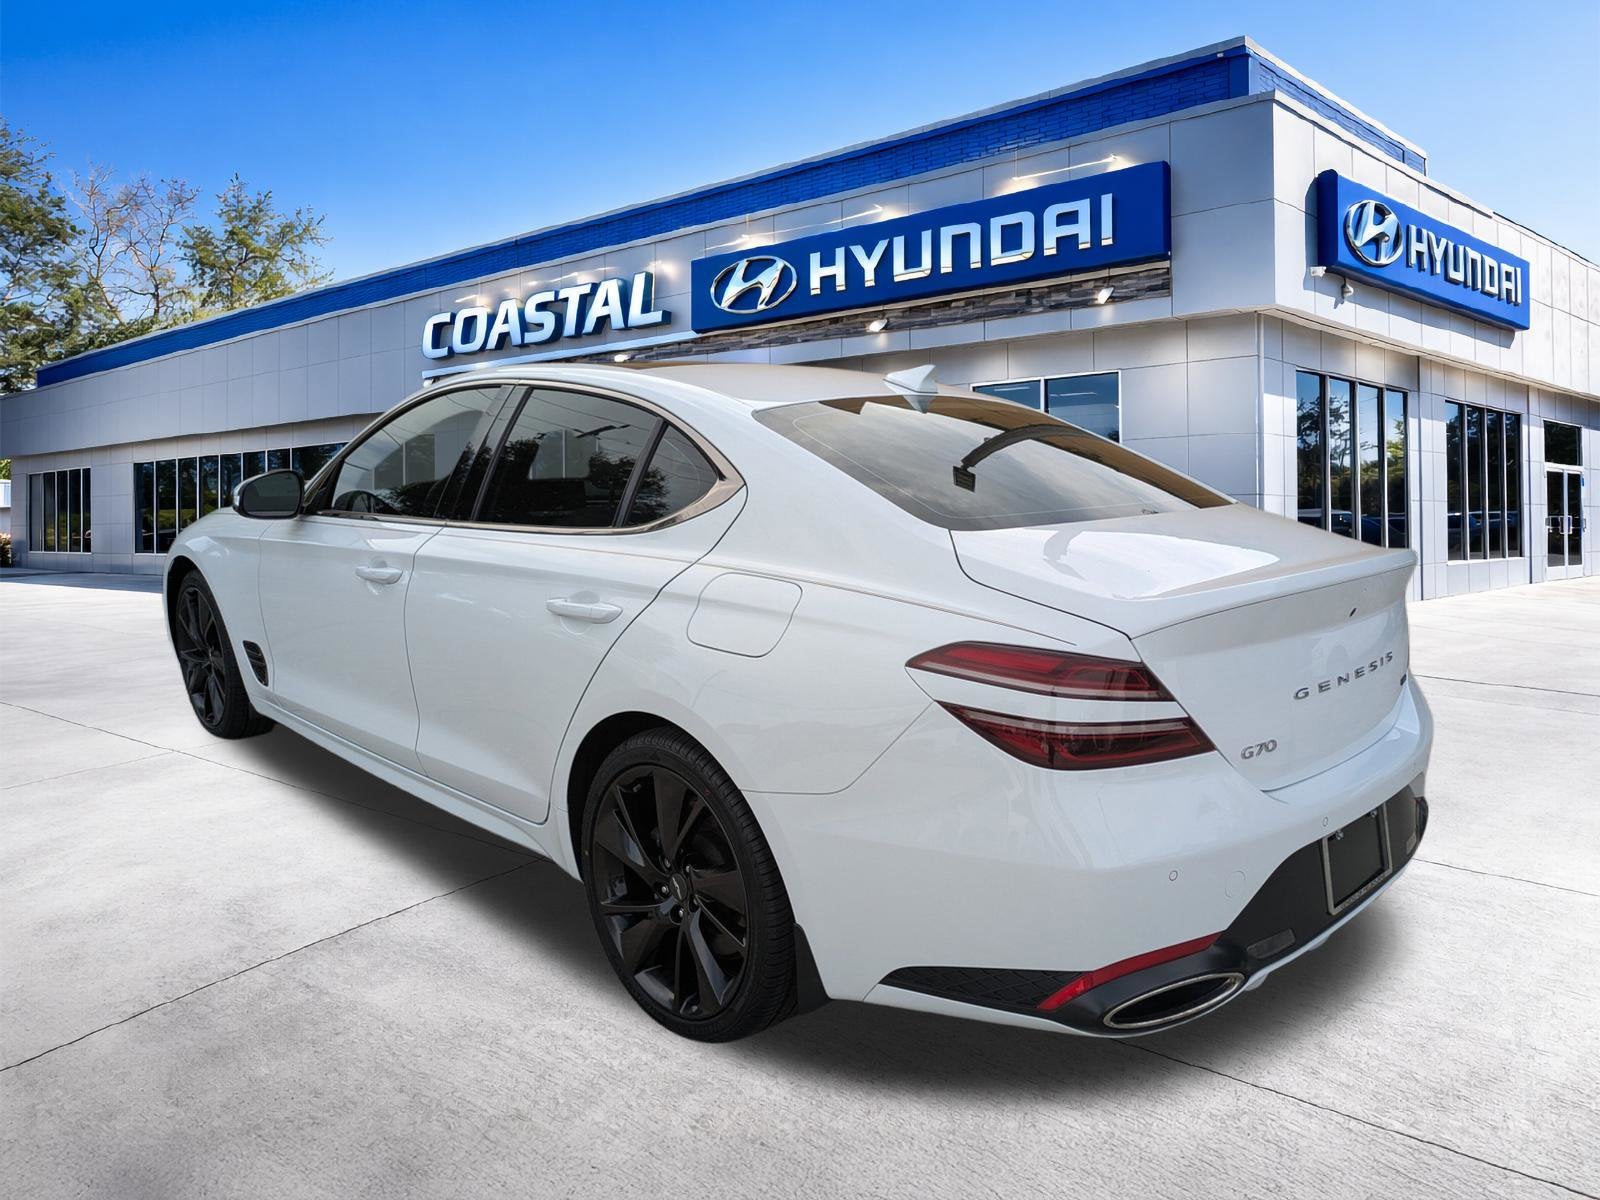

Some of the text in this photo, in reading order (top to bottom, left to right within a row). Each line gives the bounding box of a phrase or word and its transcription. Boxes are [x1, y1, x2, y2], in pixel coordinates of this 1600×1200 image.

[809, 193, 1114, 296] HYUNDAI
[1407, 224, 1522, 306] HYUNDAI
[422, 271, 671, 359] COASTAL
[1293, 651, 1393, 700] GENESIS
[1240, 739, 1278, 760] G70
